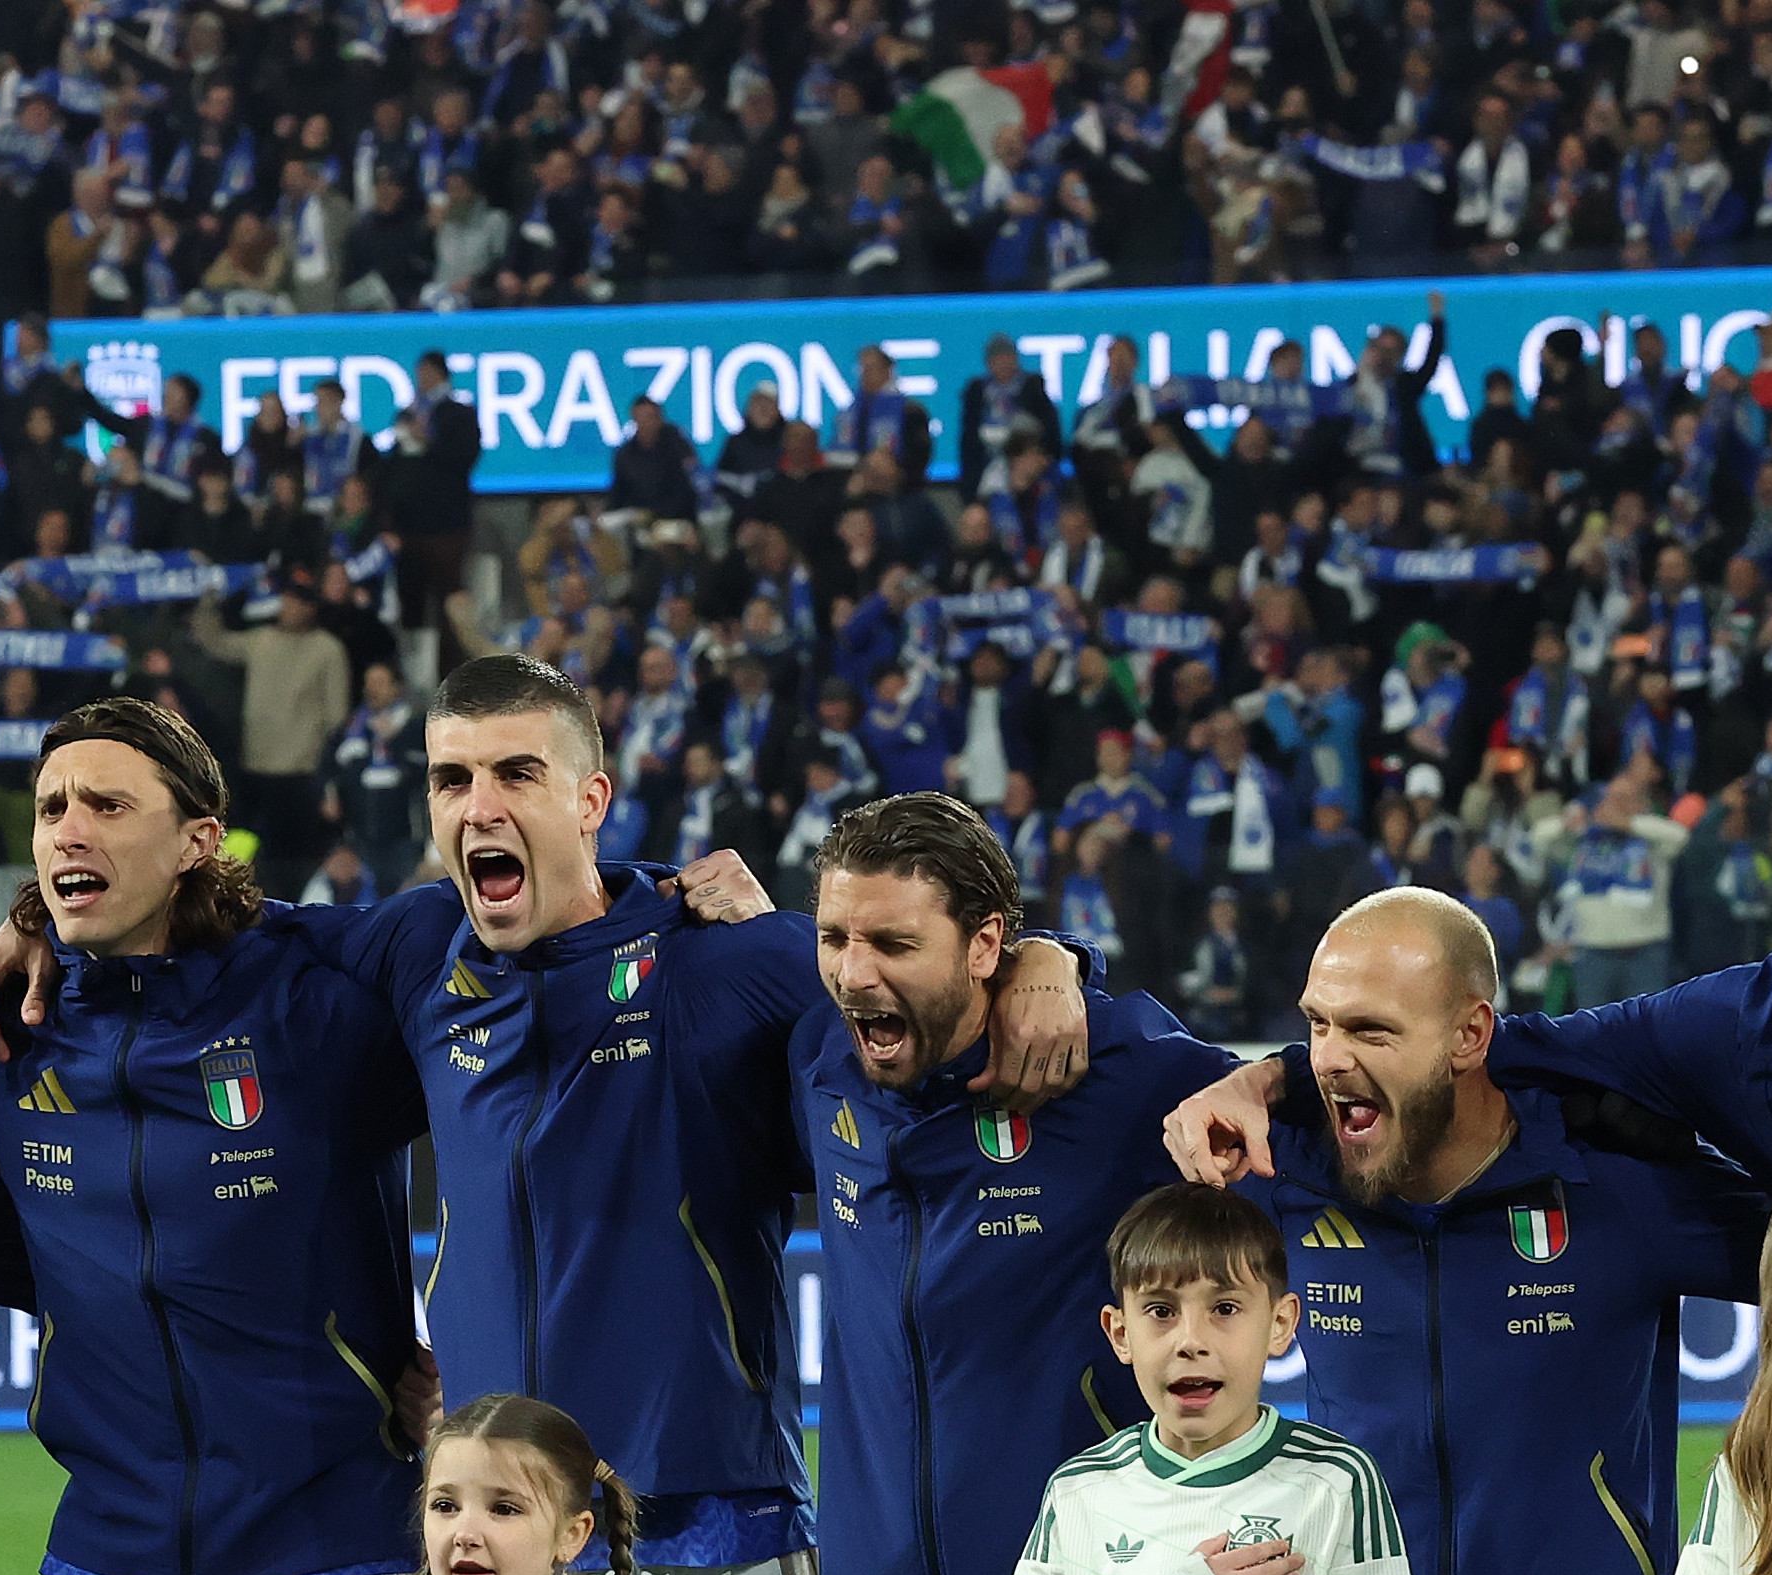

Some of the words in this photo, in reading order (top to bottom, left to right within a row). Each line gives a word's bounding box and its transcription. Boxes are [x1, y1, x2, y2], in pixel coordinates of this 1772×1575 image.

[449, 1045, 486, 1073] Poste
[590, 1040, 624, 1063] eni
[40, 1143, 72, 1165] TIM
[220, 1147, 276, 1165] Telepass
[25, 1167, 75, 1192] Poste
[213, 1177, 250, 1200] eni
[988, 1185, 1042, 1200] Telepass
[978, 1215, 1013, 1237] eni
[1325, 1283, 1363, 1304] TIM
[1518, 1282, 1576, 1298] Telepass
[1308, 1310, 1363, 1332] Poste
[1507, 1312, 1544, 1335] eni
